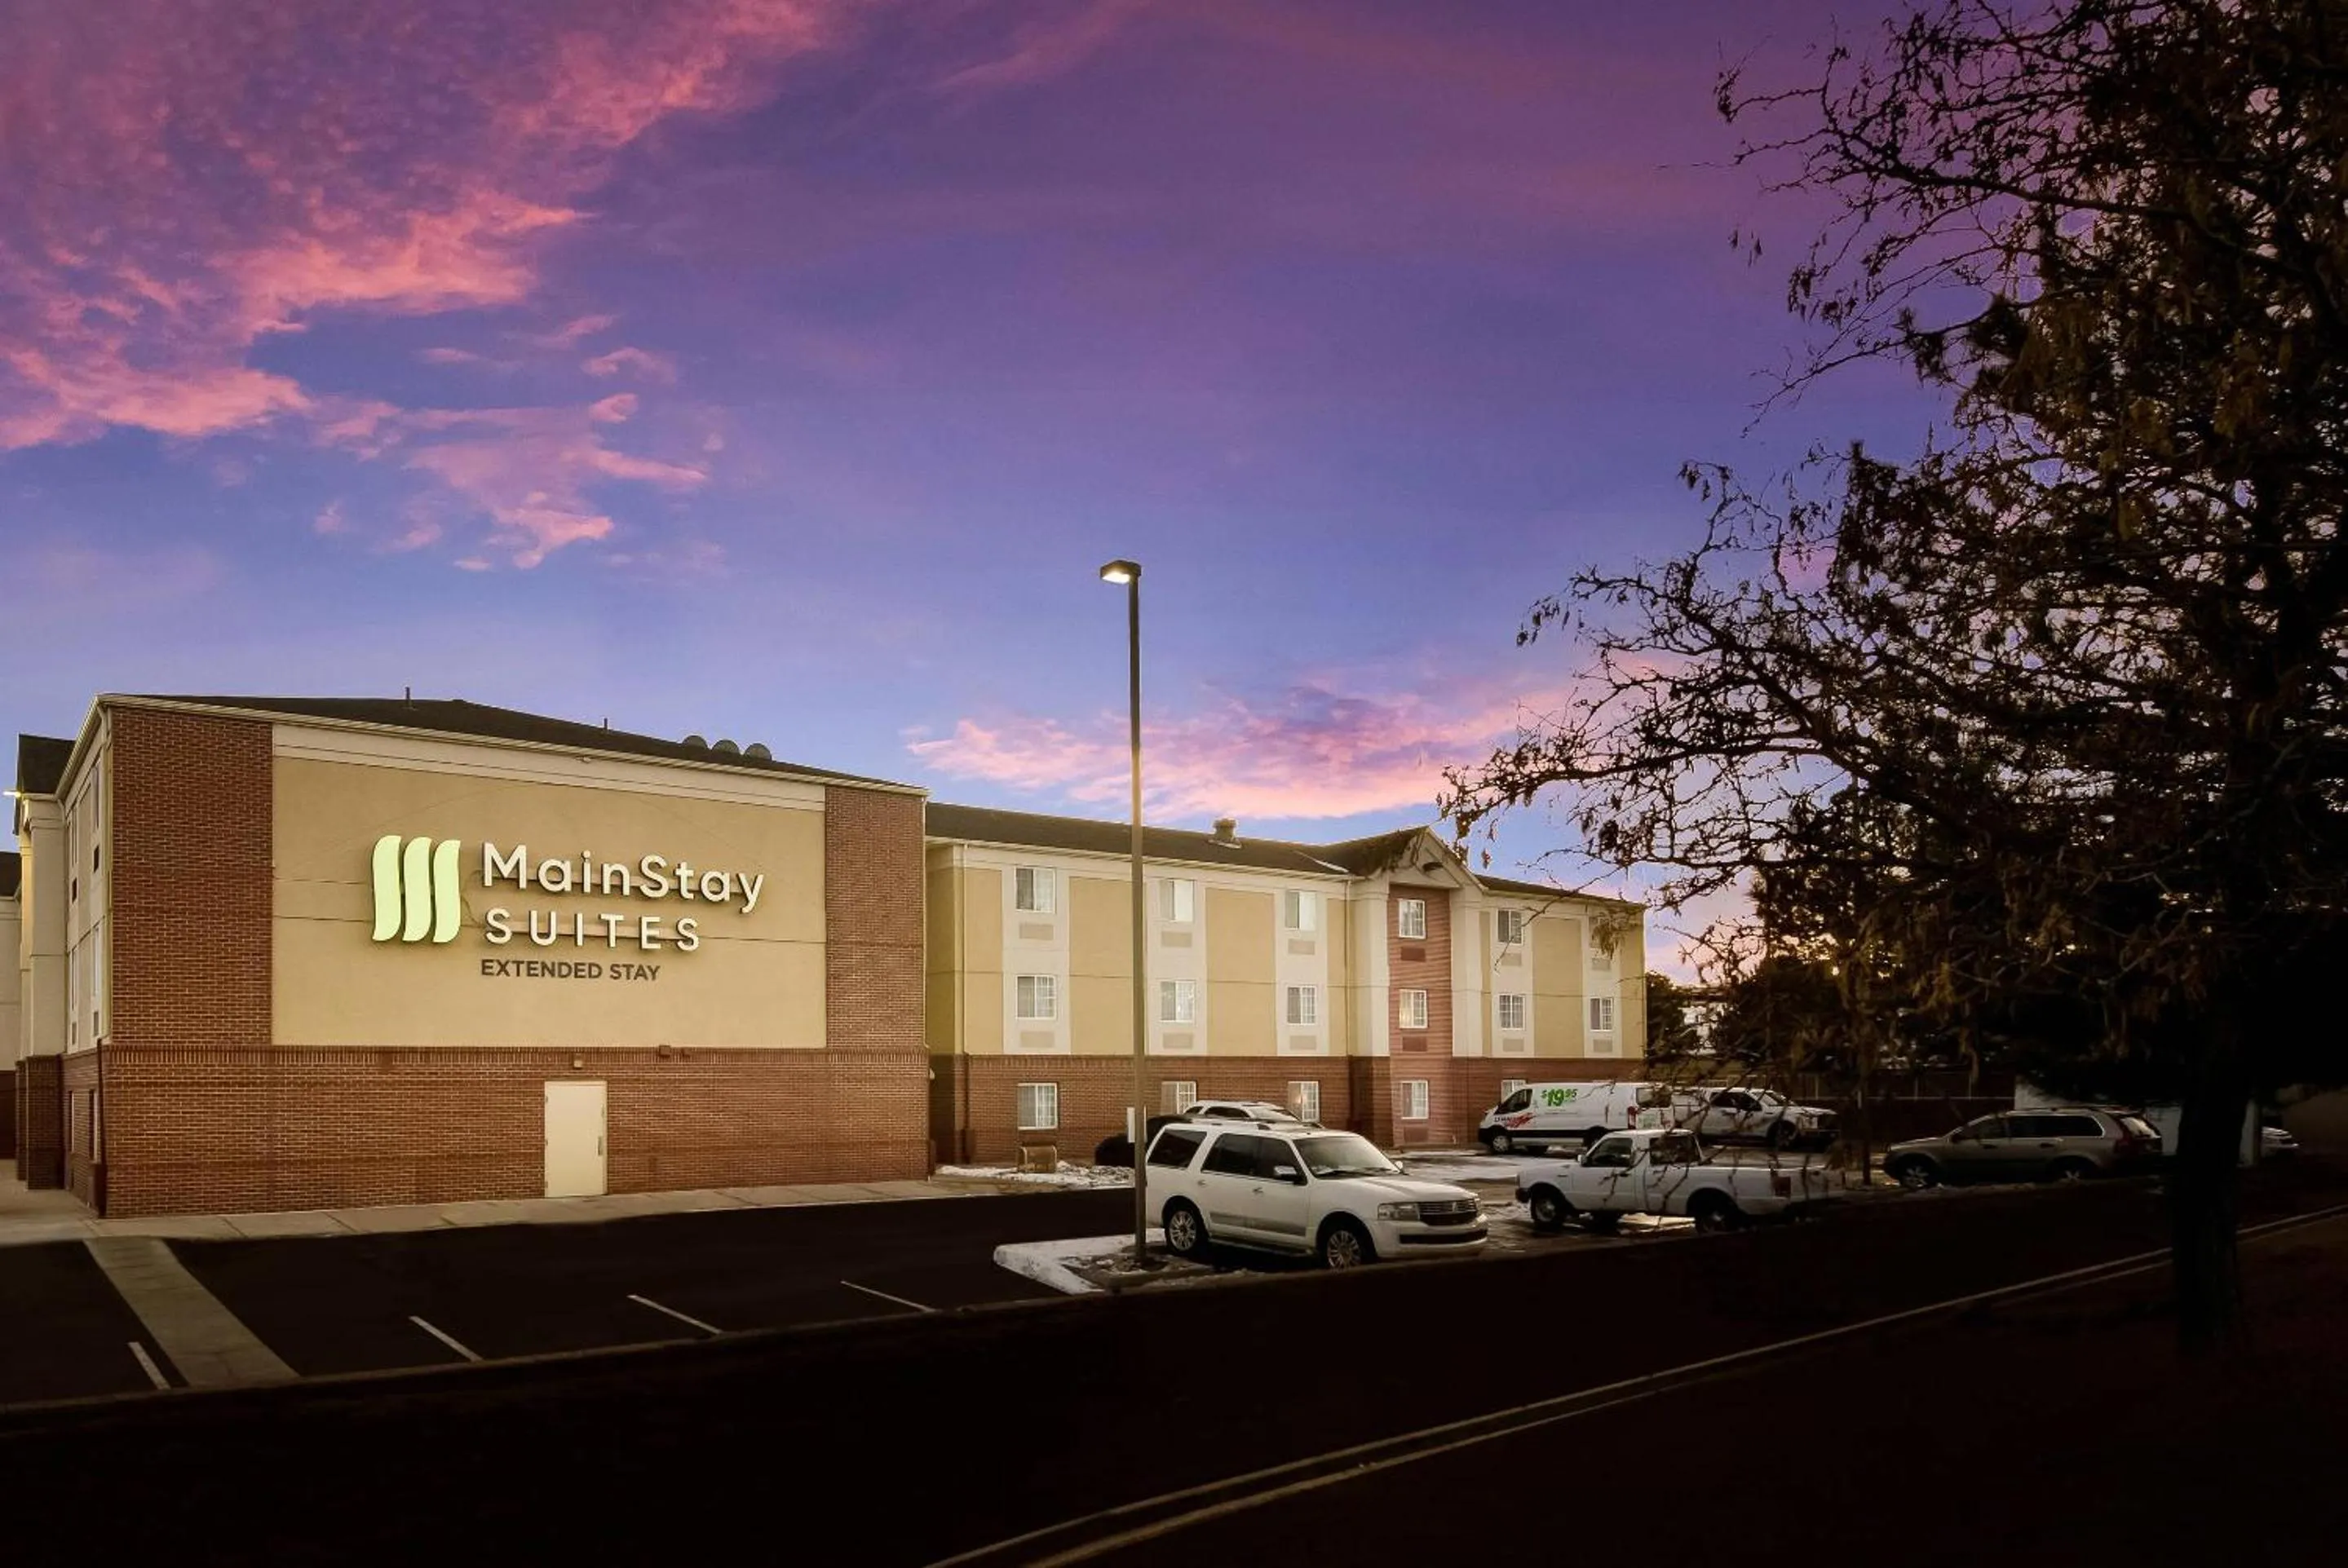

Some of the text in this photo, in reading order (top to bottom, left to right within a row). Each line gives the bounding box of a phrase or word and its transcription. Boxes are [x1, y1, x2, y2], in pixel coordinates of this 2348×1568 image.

[483, 841, 764, 914] MainStay
[485, 908, 700, 952] SUITES
[481, 959, 661, 980] EXTENDED STAY
